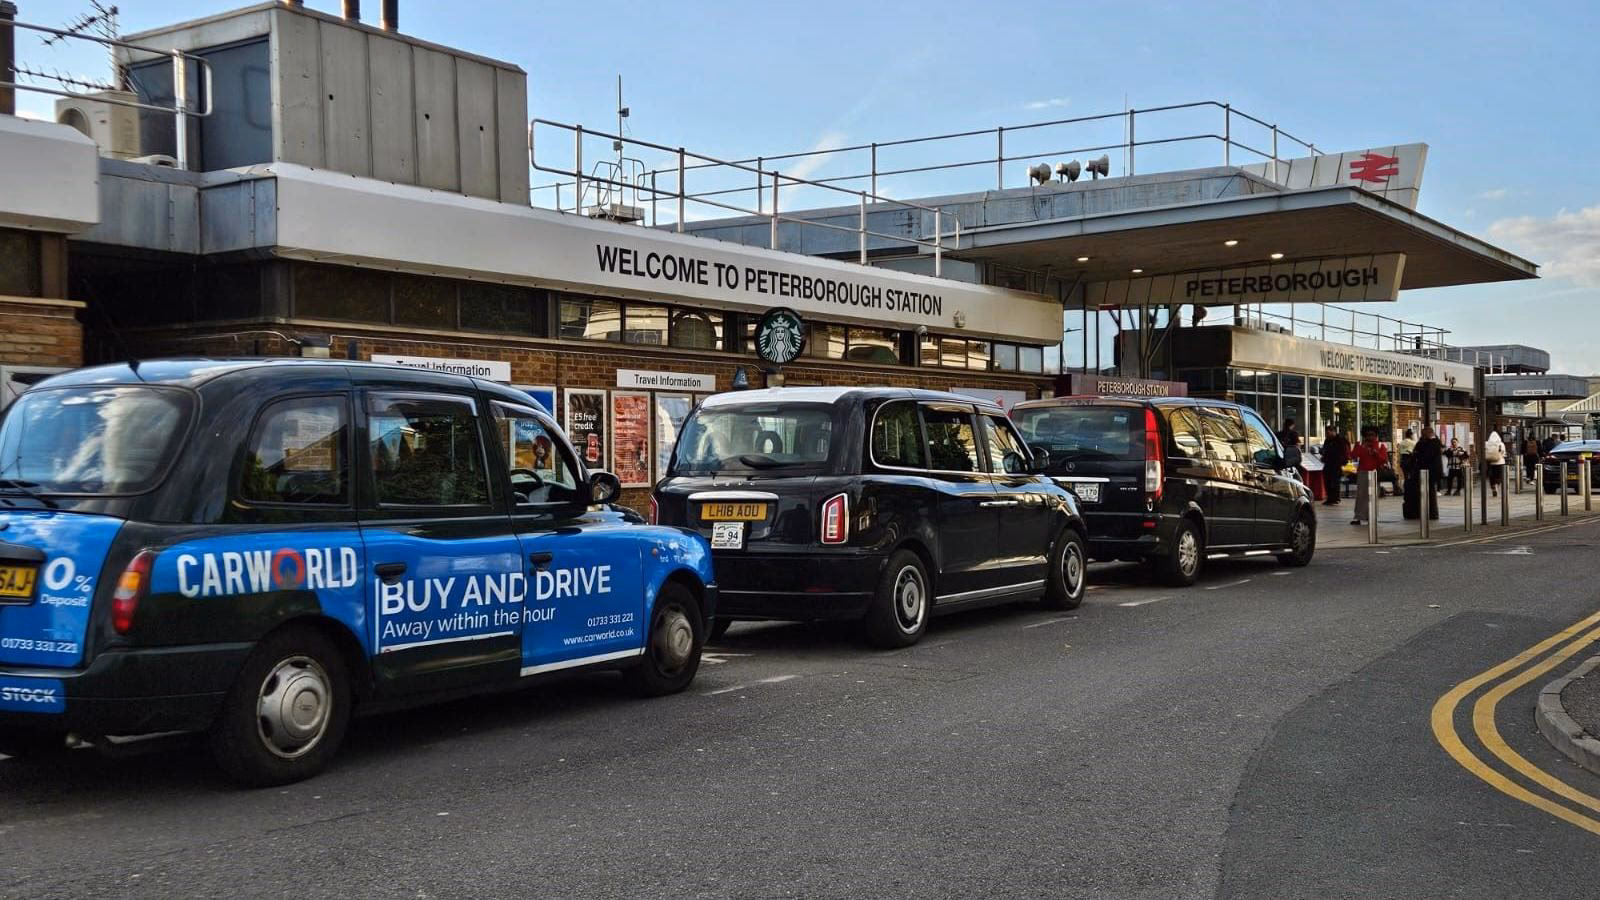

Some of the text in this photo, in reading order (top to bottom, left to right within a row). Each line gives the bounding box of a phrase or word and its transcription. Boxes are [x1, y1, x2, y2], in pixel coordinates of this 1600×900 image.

[597, 244, 942, 316] WELCOME TO PETERBOROUGH STATION
[1186, 267, 1378, 297] PETERBOROUGH
[1320, 350, 1434, 380] WELCOME TO PETERBOROUGH STATION
[634, 373, 701, 387] Travel Information
[1098, 381, 1169, 396] PETERBOROUGH STATION
[583, 412, 597, 421] free
[574, 422, 594, 430] credit
[709, 505, 734, 517] LH18
[728, 531, 738, 541] 94
[176, 547, 357, 598] CARWORLD
[381, 565, 611, 615] BUY AND DRIVE
[40, 594, 88, 607] Deposit
[382, 605, 556, 640] Away within the hour
[588, 613, 634, 627] 01733 331 221
[564, 627, 634, 645] www.carworld.co.uk
[1, 638, 79, 653] 01733 331 221
[2, 687, 57, 703] STOCK
